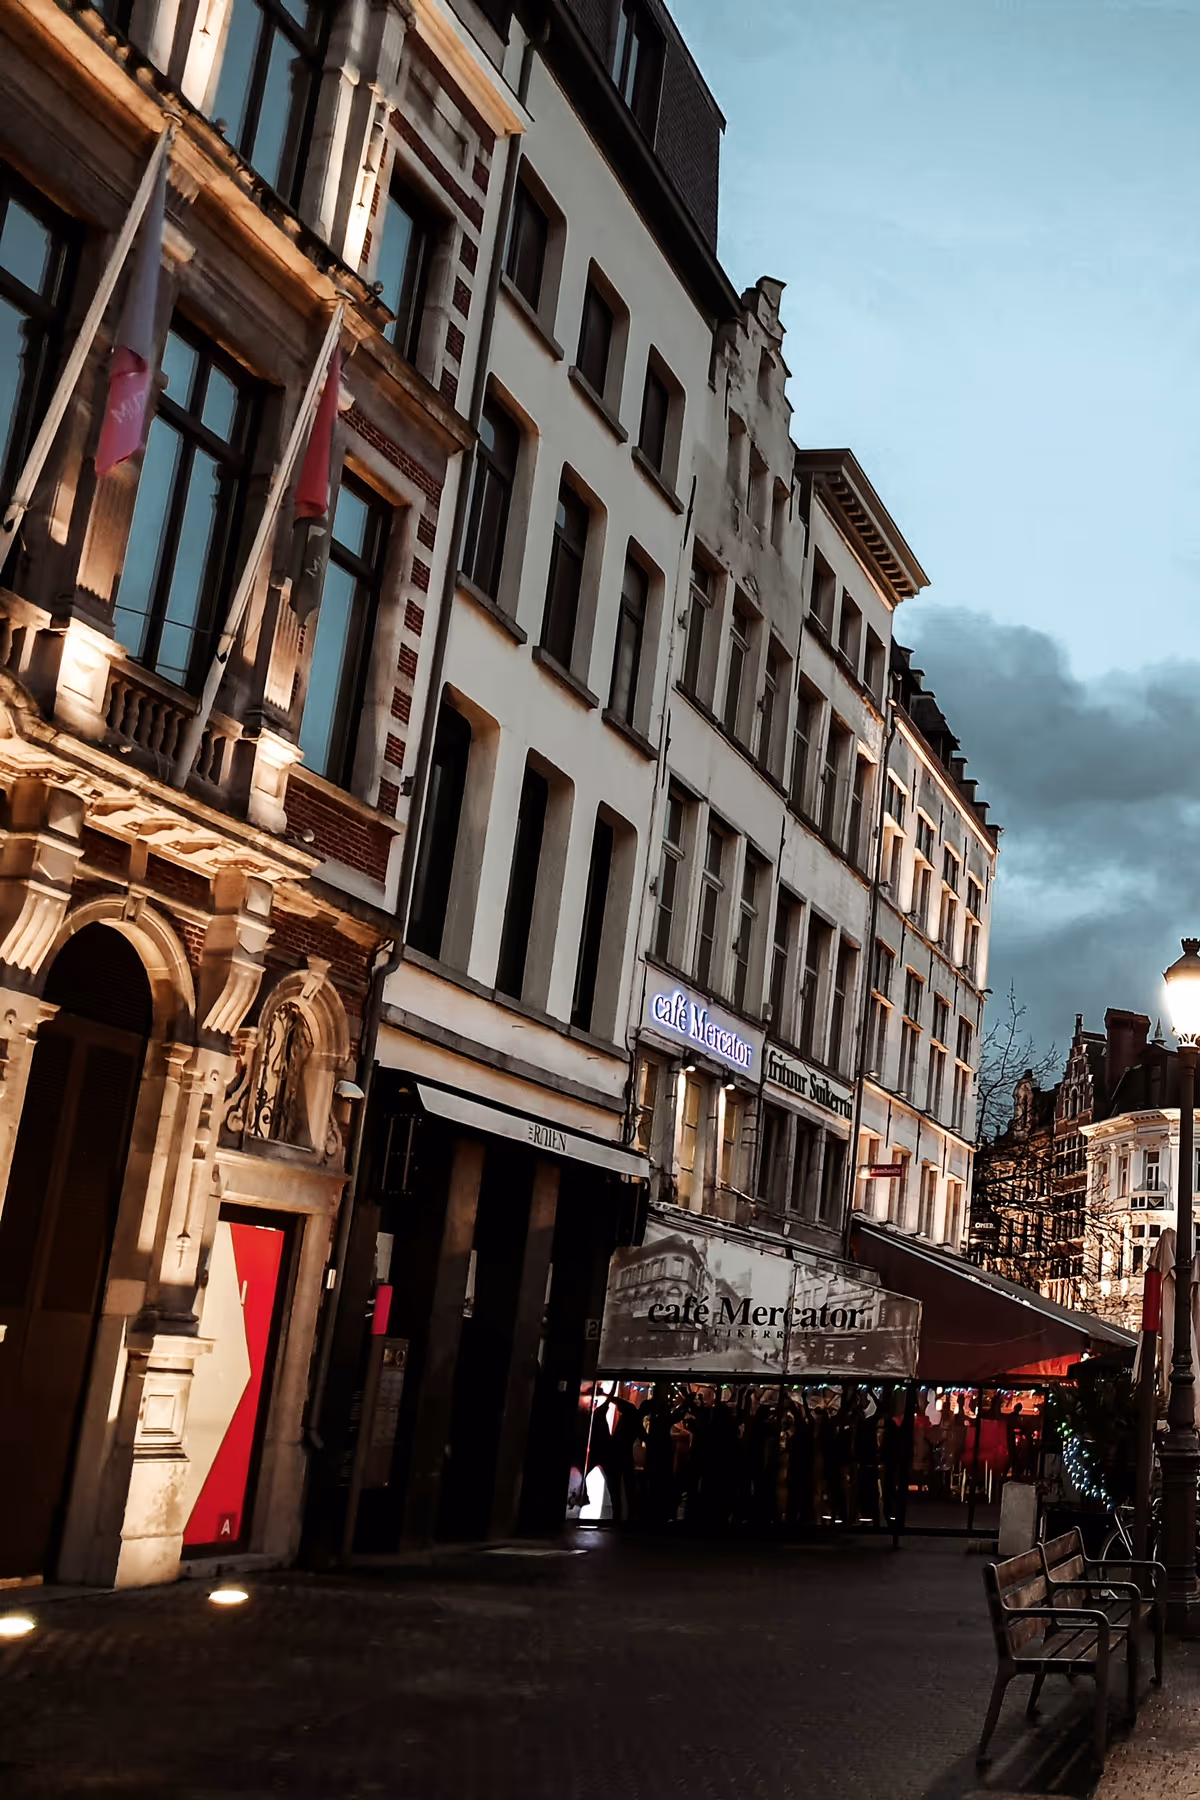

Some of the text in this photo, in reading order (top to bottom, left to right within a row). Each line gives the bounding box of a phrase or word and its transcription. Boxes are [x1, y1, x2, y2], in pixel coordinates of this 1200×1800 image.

[654, 993, 753, 1068] café Mercator
[767, 1049, 808, 1096] frituur
[648, 1293, 710, 1326] café
[718, 1296, 865, 1330] Mercator
[219, 1518, 231, 1536] A
